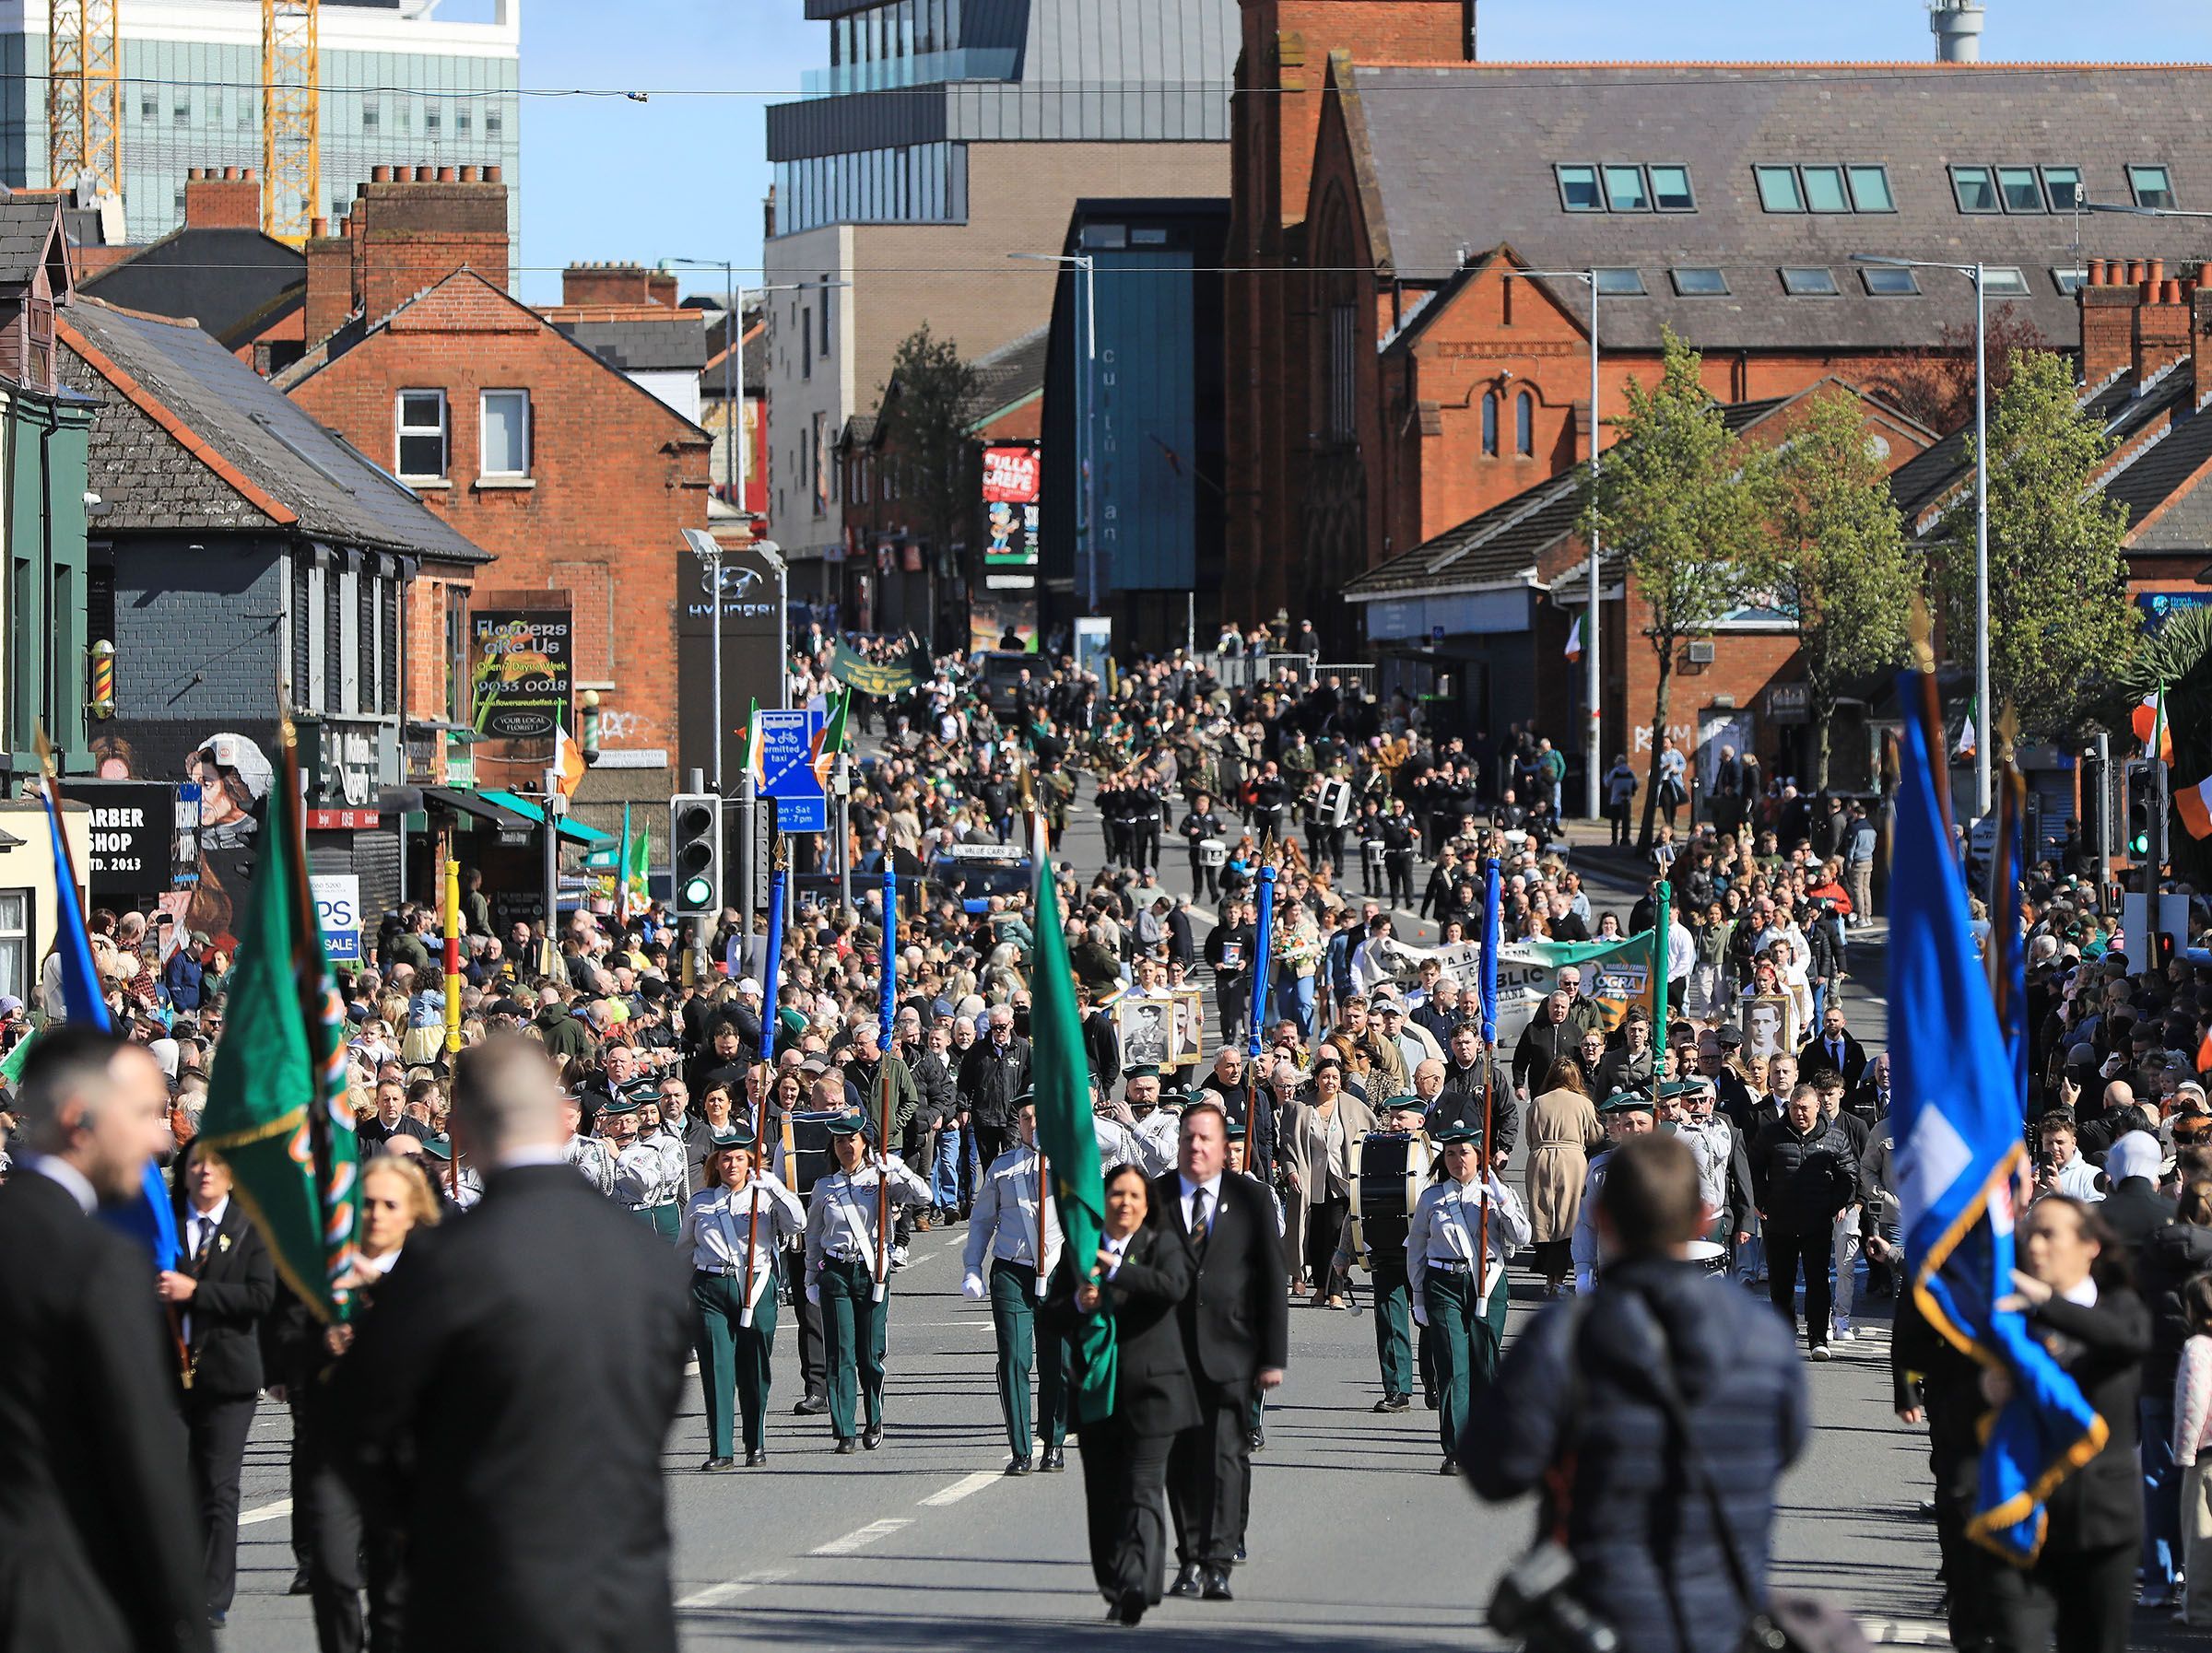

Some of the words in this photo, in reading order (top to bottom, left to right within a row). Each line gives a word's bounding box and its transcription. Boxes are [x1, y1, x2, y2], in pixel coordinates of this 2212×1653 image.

[532, 638, 560, 655] Us
[477, 698, 568, 708] www.flowersareusbelfast.cm
[764, 745, 800, 755] ermitted
[771, 755, 788, 763] taxi
[778, 806, 789, 815] on
[795, 805, 811, 815] Sat
[89, 808, 145, 828] ARBER
[89, 858, 108, 872] TD.
[111, 858, 142, 872] 2013
[315, 900, 352, 927] PS
[324, 938, 353, 951] SALE
[1496, 967, 1545, 989] BLIC
